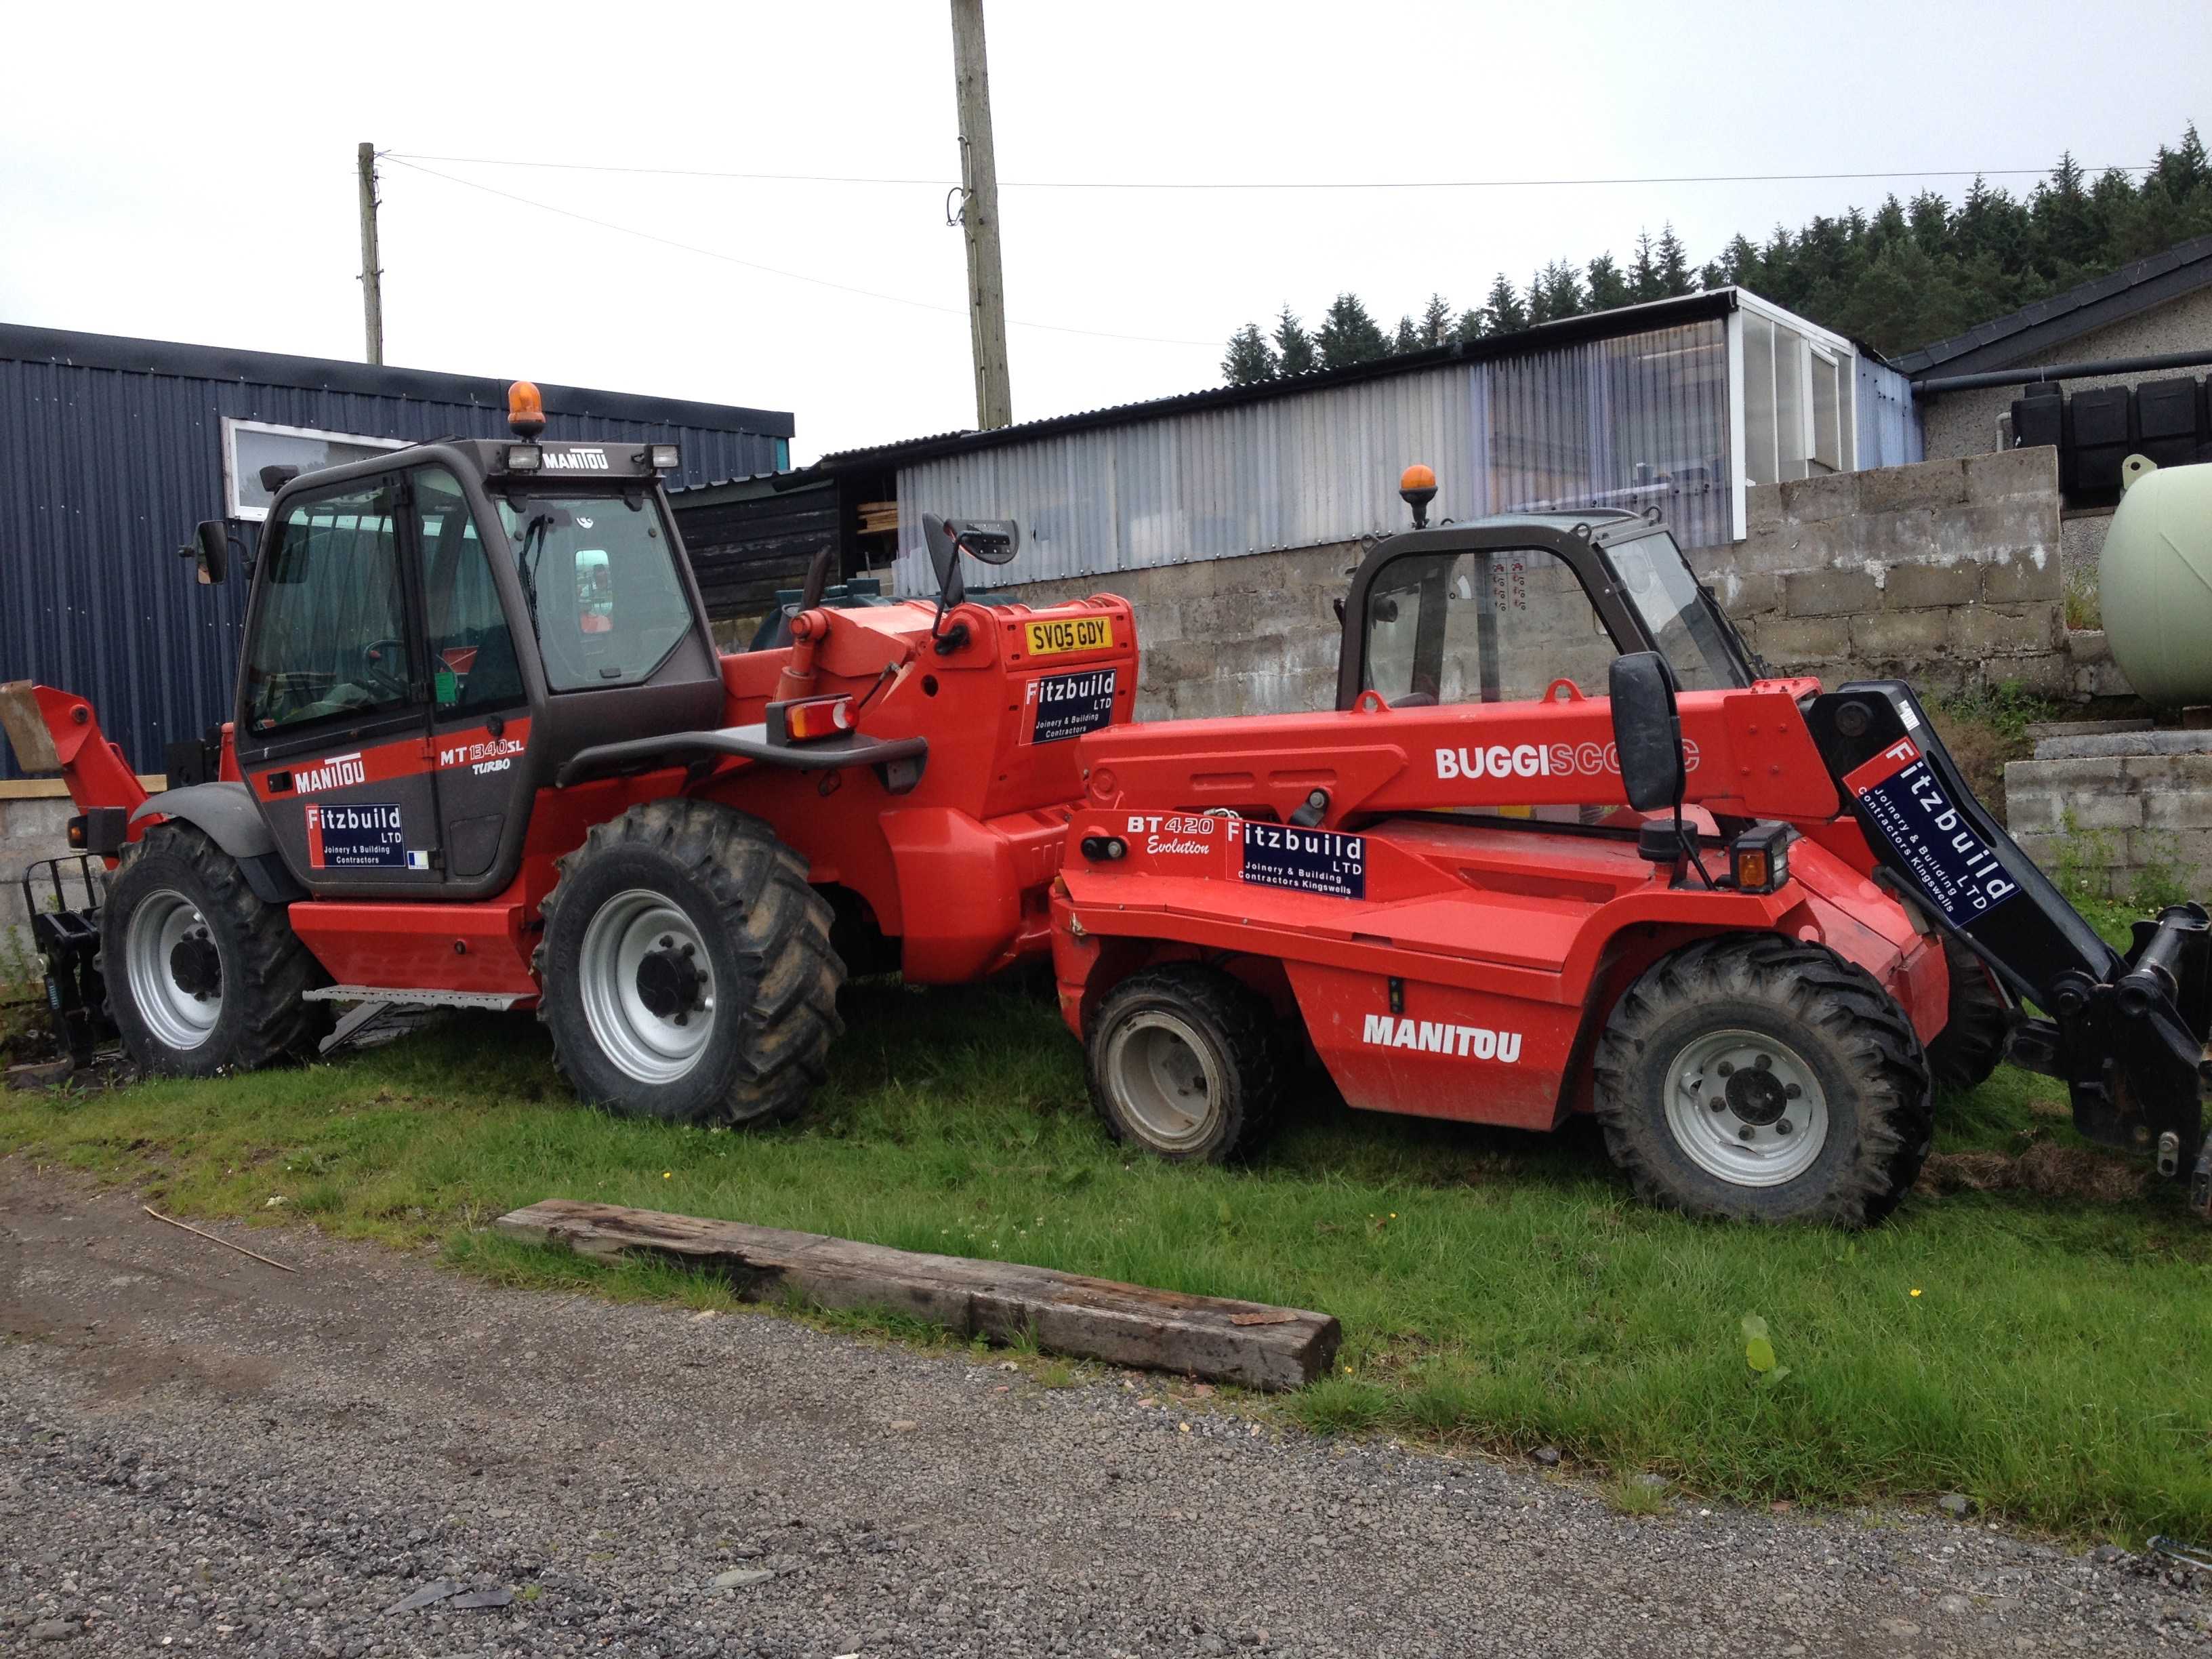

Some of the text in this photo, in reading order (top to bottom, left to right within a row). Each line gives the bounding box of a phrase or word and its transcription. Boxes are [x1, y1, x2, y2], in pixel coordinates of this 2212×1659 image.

[542, 449, 609, 469] MANITOU
[1033, 621, 1105, 649] SV05 GDY
[1026, 672, 1115, 704] Fitzbuild
[1093, 697, 1111, 710] LTD
[1036, 719, 1061, 729] Joinery
[1071, 713, 1099, 726] Building
[1046, 725, 1087, 738] Contractors
[441, 747, 467, 766] MT
[472, 758, 510, 775] TURBO
[295, 752, 365, 794] MANITOU
[308, 808, 401, 830] Fitzbuild
[1885, 741, 2015, 899] Fitzbuild
[382, 832, 401, 843] LTD
[1147, 836, 1209, 855] Evolution
[1228, 821, 1361, 859] Fitzbuild
[1874, 788, 1958, 896] Joinery & Building
[1858, 786, 1911, 856] Contractors
[1910, 857, 1954, 913] Kingswells
[1246, 862, 1283, 876] Joinery
[1298, 869, 1342, 883] Building
[1332, 861, 1361, 875] LTD
[1238, 871, 1351, 895] Contractors Kingswells
[1957, 875, 1988, 909] LTD
[1363, 1014, 1522, 1063] MANITOU
